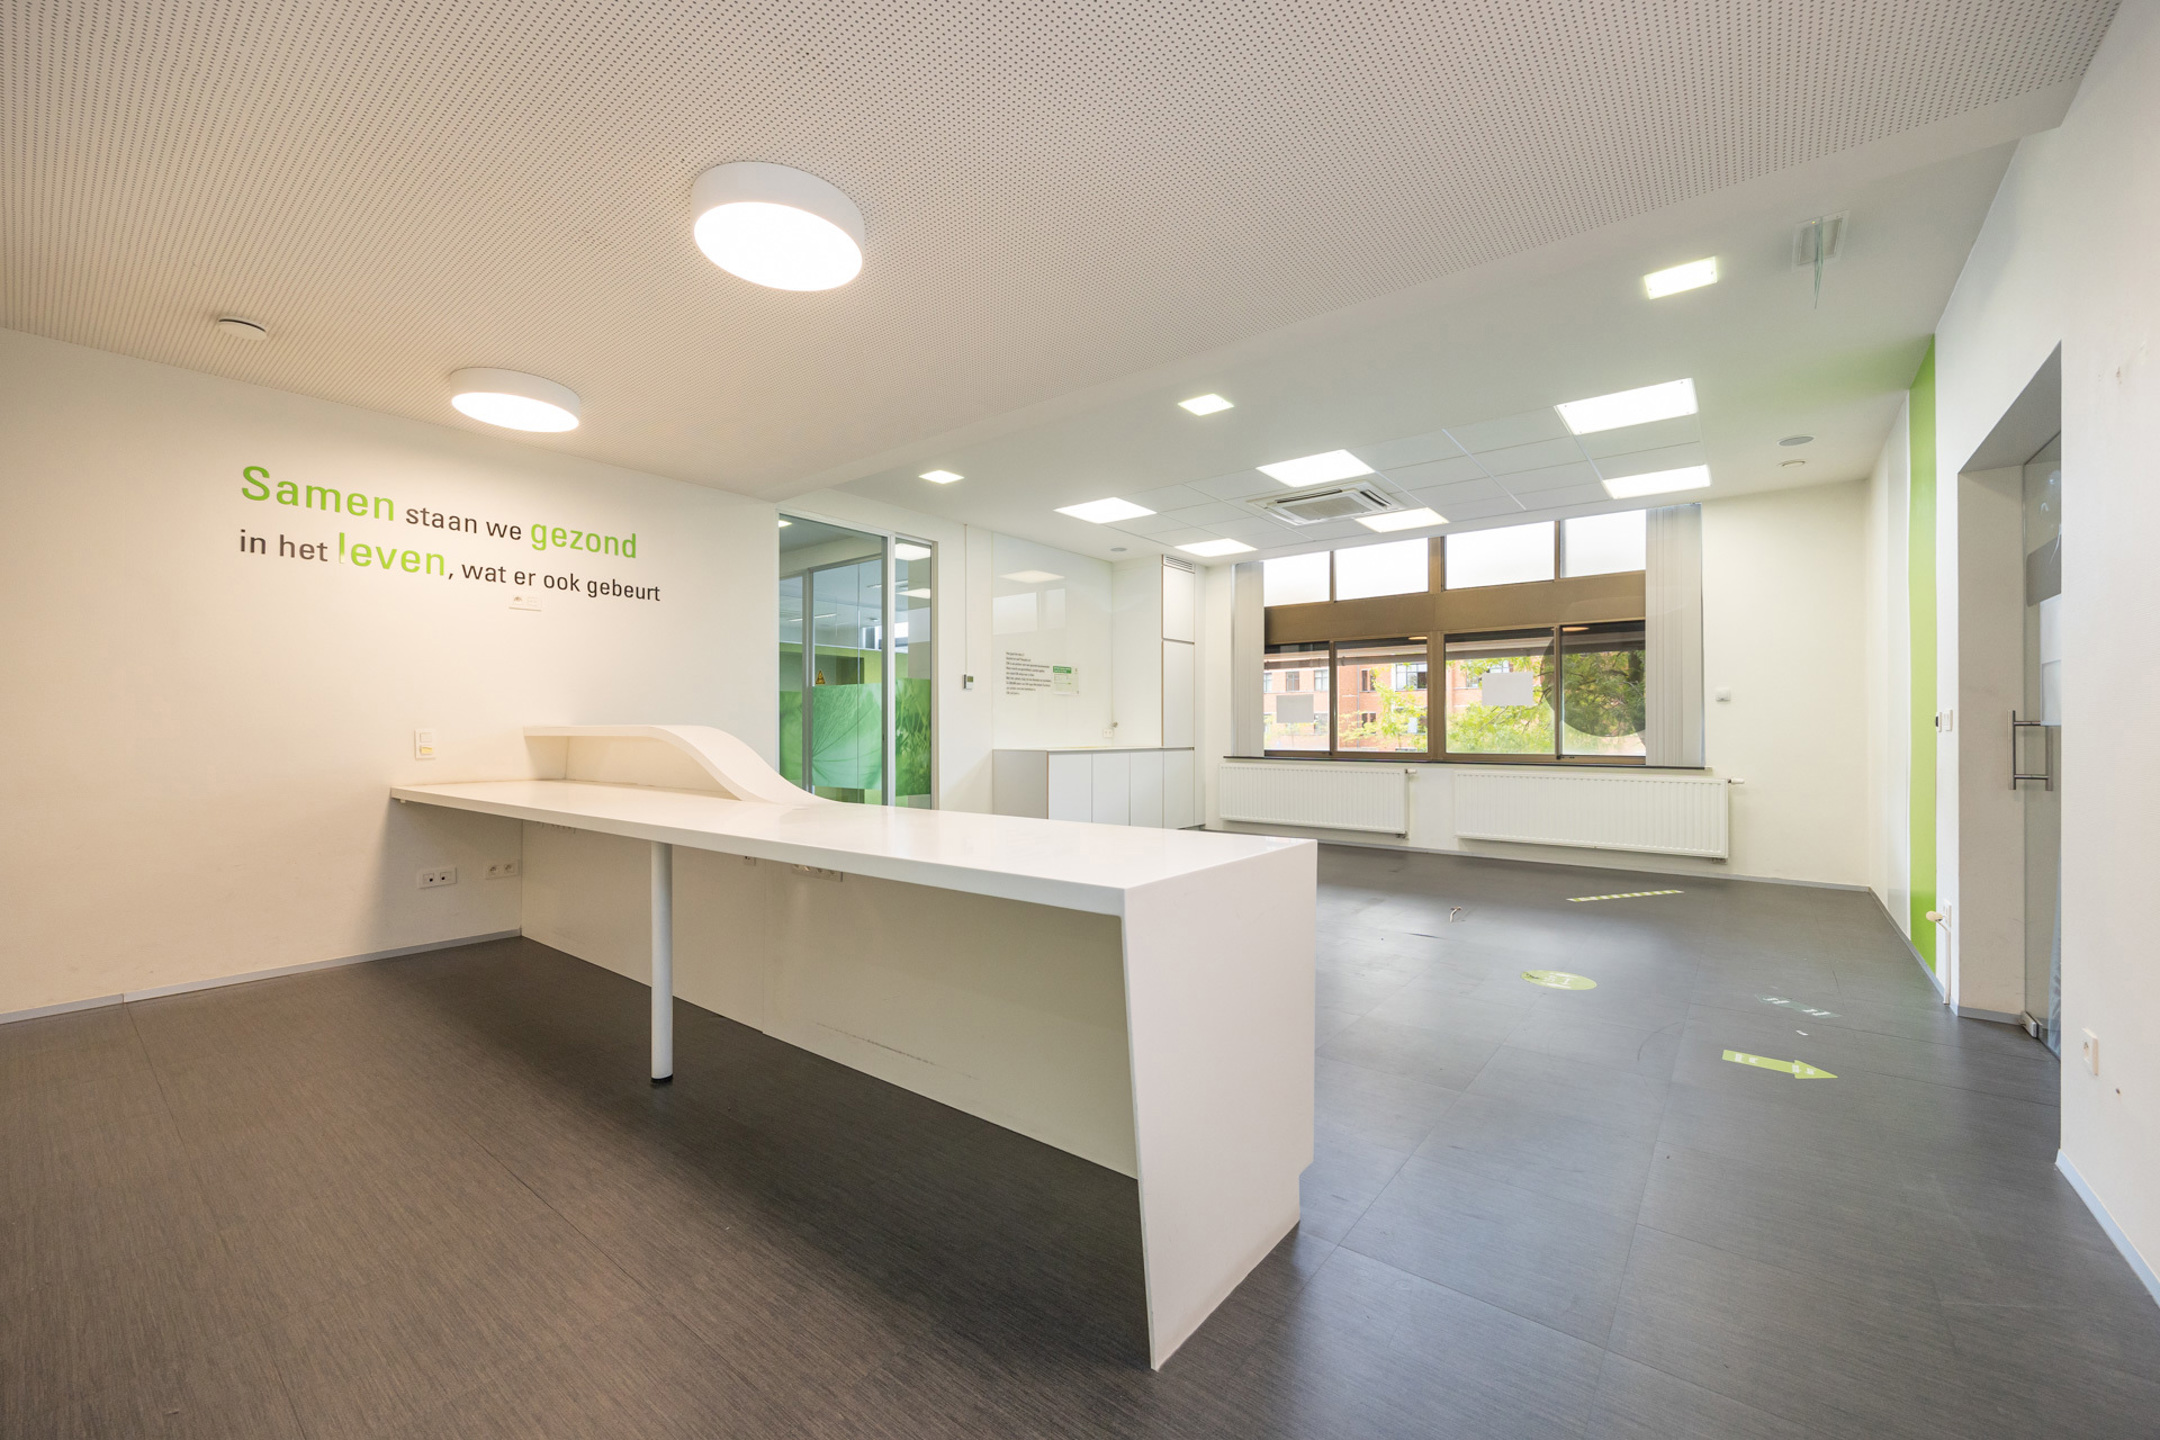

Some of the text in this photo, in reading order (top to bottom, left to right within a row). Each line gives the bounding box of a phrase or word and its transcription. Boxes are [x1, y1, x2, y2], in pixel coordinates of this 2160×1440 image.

[241, 465, 637, 559] Samen staan we gezond
[240, 529, 661, 602] in het leven, wat er ook gebeurt
